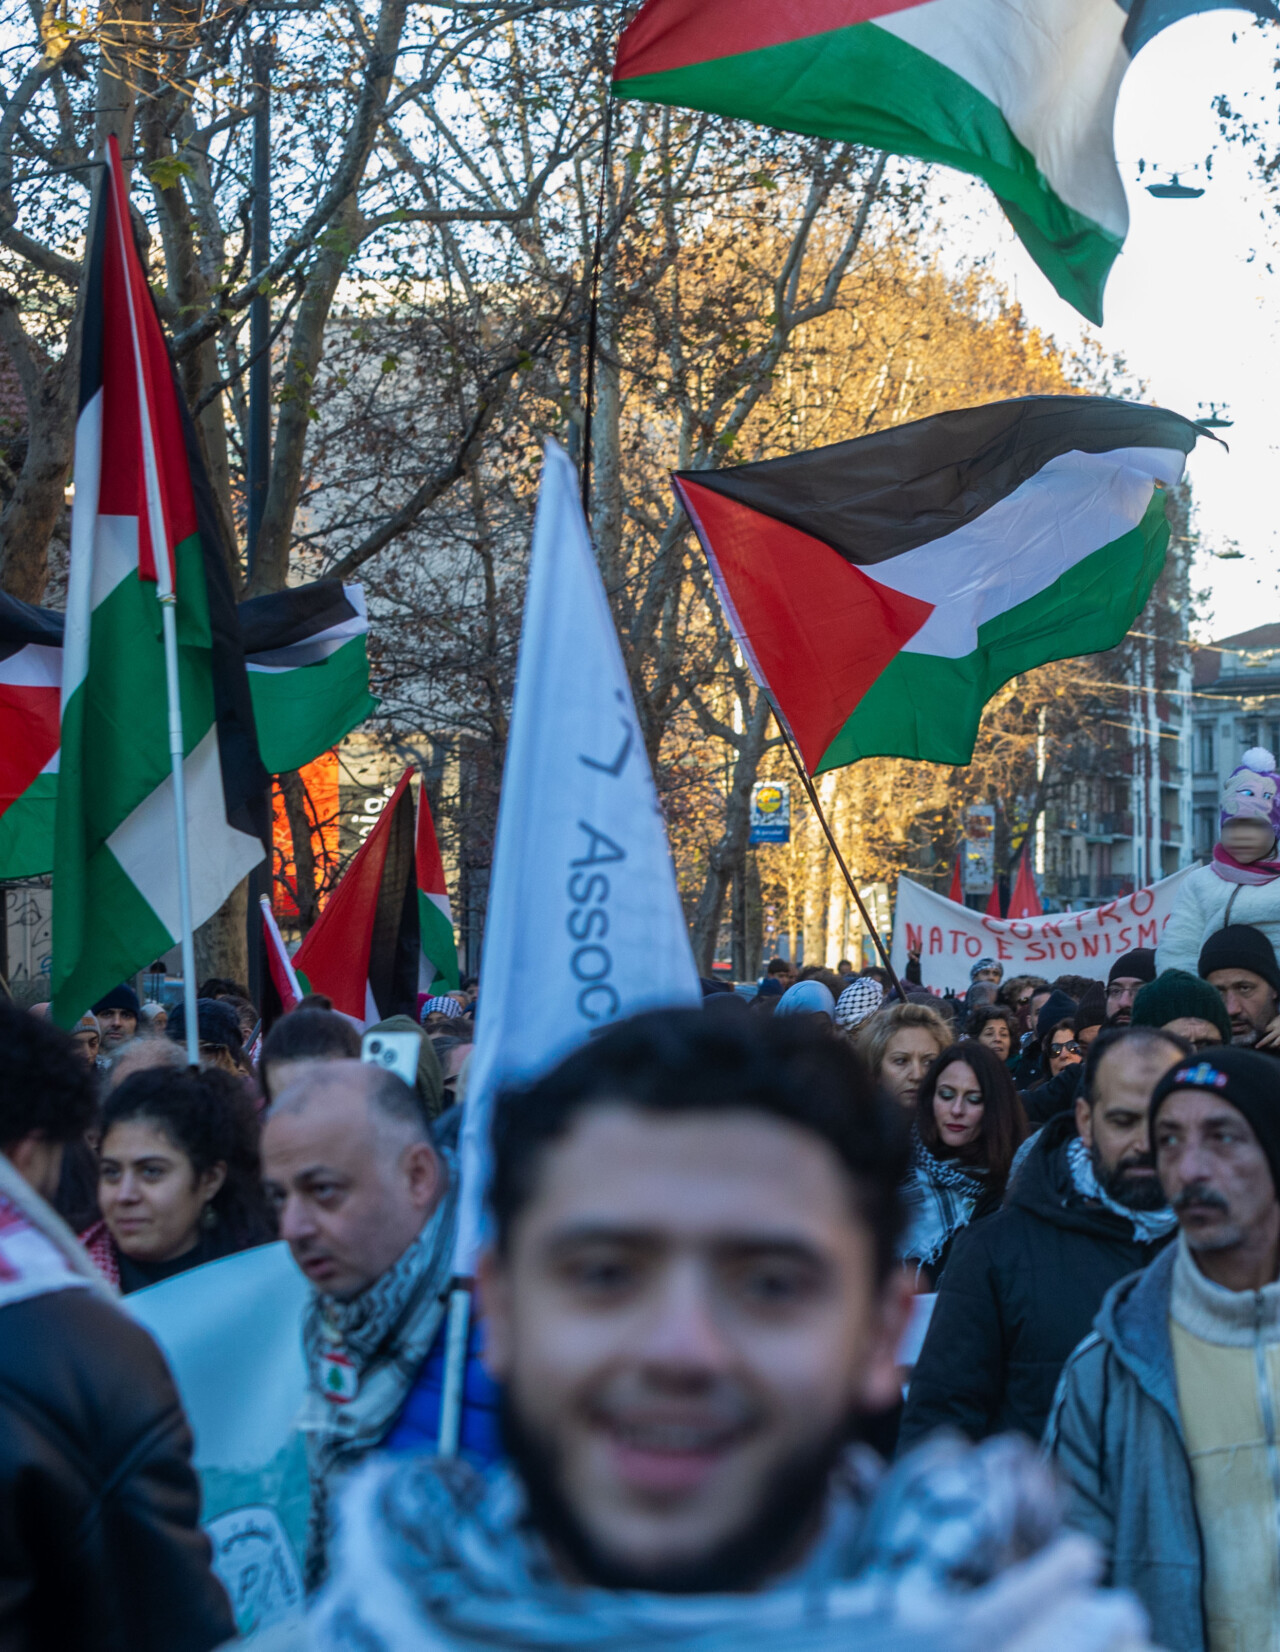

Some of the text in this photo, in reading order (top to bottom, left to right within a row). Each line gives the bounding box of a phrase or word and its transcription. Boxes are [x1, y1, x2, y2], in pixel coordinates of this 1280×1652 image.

[904, 914, 1170, 961] NATO E SIONISM
[981, 888, 1155, 940] CONTRO
